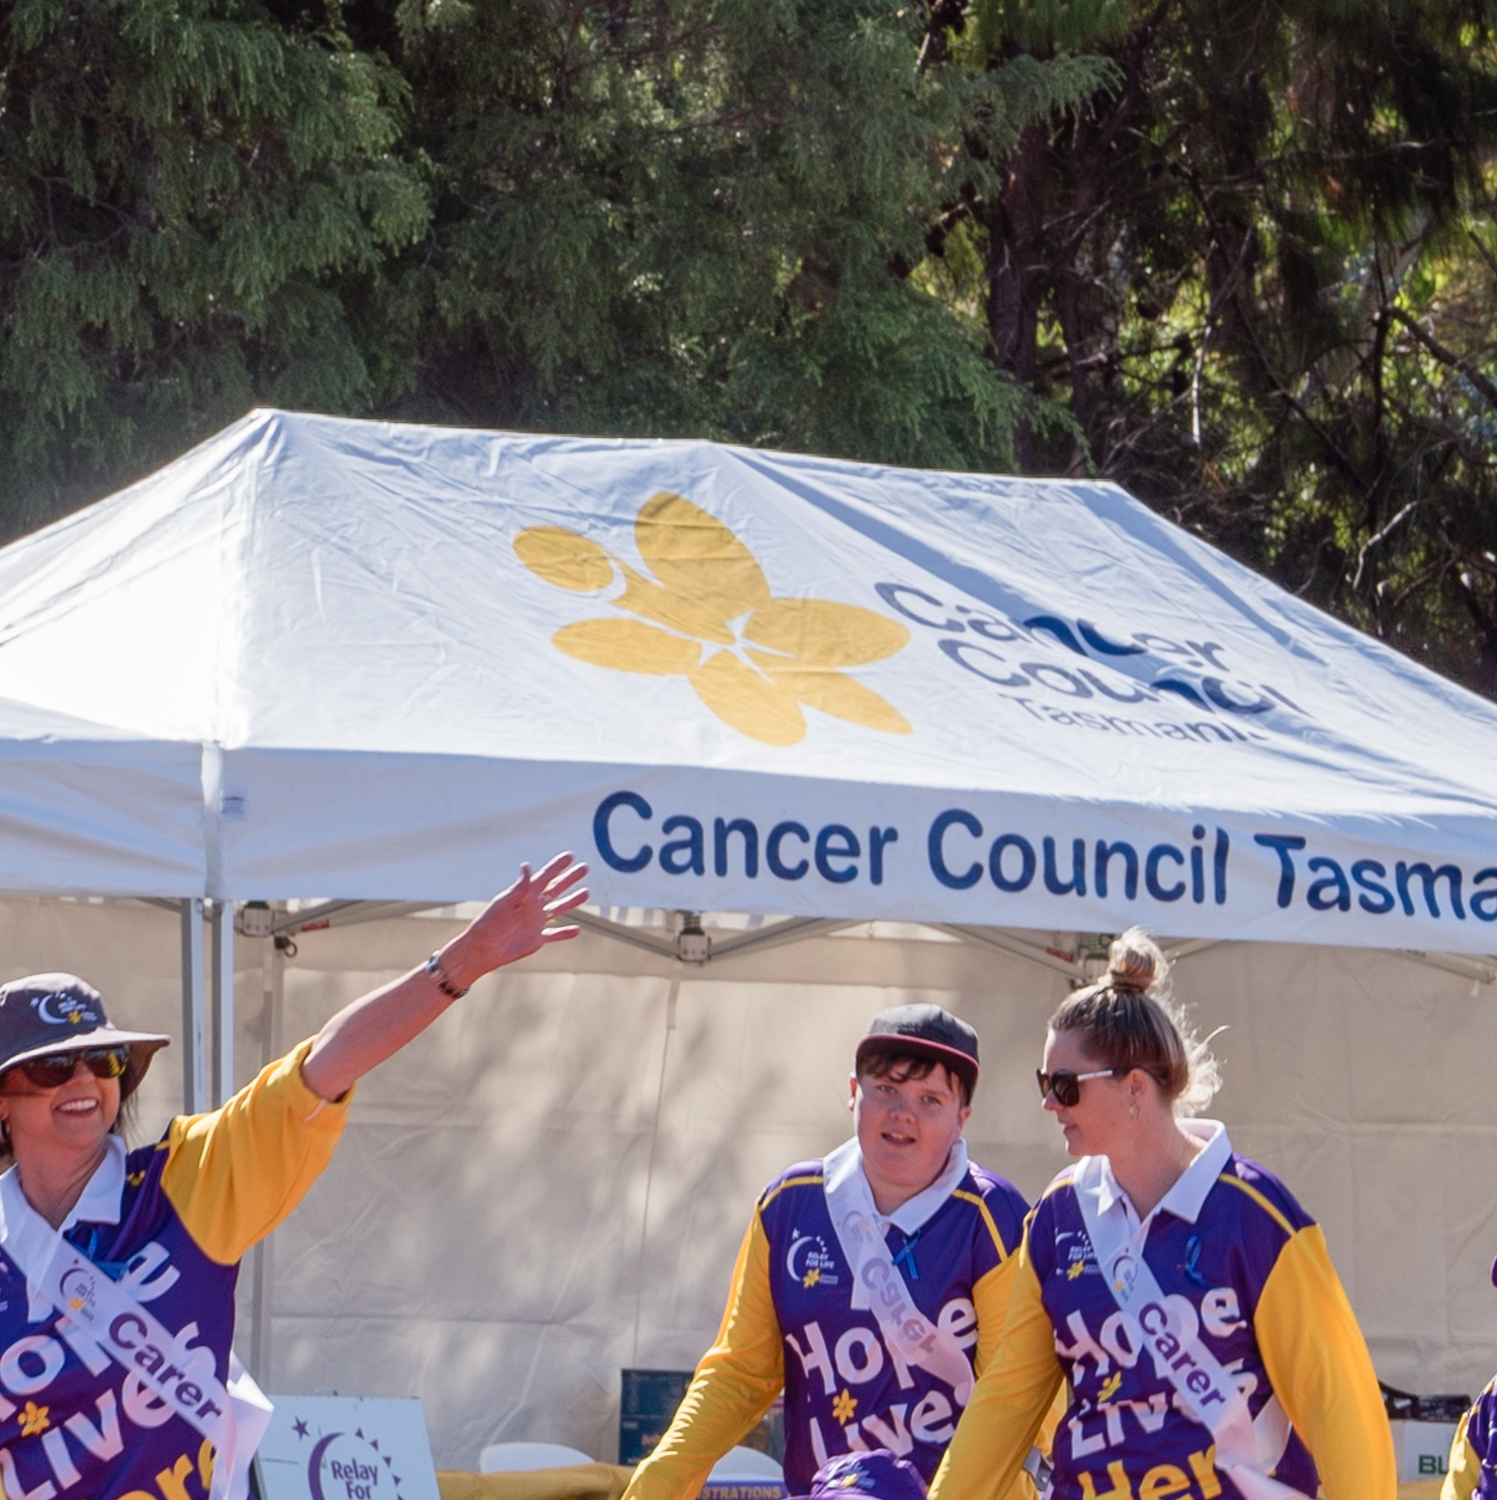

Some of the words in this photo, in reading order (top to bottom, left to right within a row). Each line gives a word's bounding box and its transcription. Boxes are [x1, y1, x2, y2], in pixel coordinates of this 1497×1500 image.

[874, 582, 1230, 672] Cancer
[592, 790, 899, 886] Cancer
[927, 808, 1230, 905] Council
[108, 1311, 223, 1432] Carer
[1138, 1300, 1227, 1407] Carer
[809, 1382, 967, 1470] Live
[331, 1460, 378, 1486] Relay
[700, 1486, 782, 1500] STRATIONS
